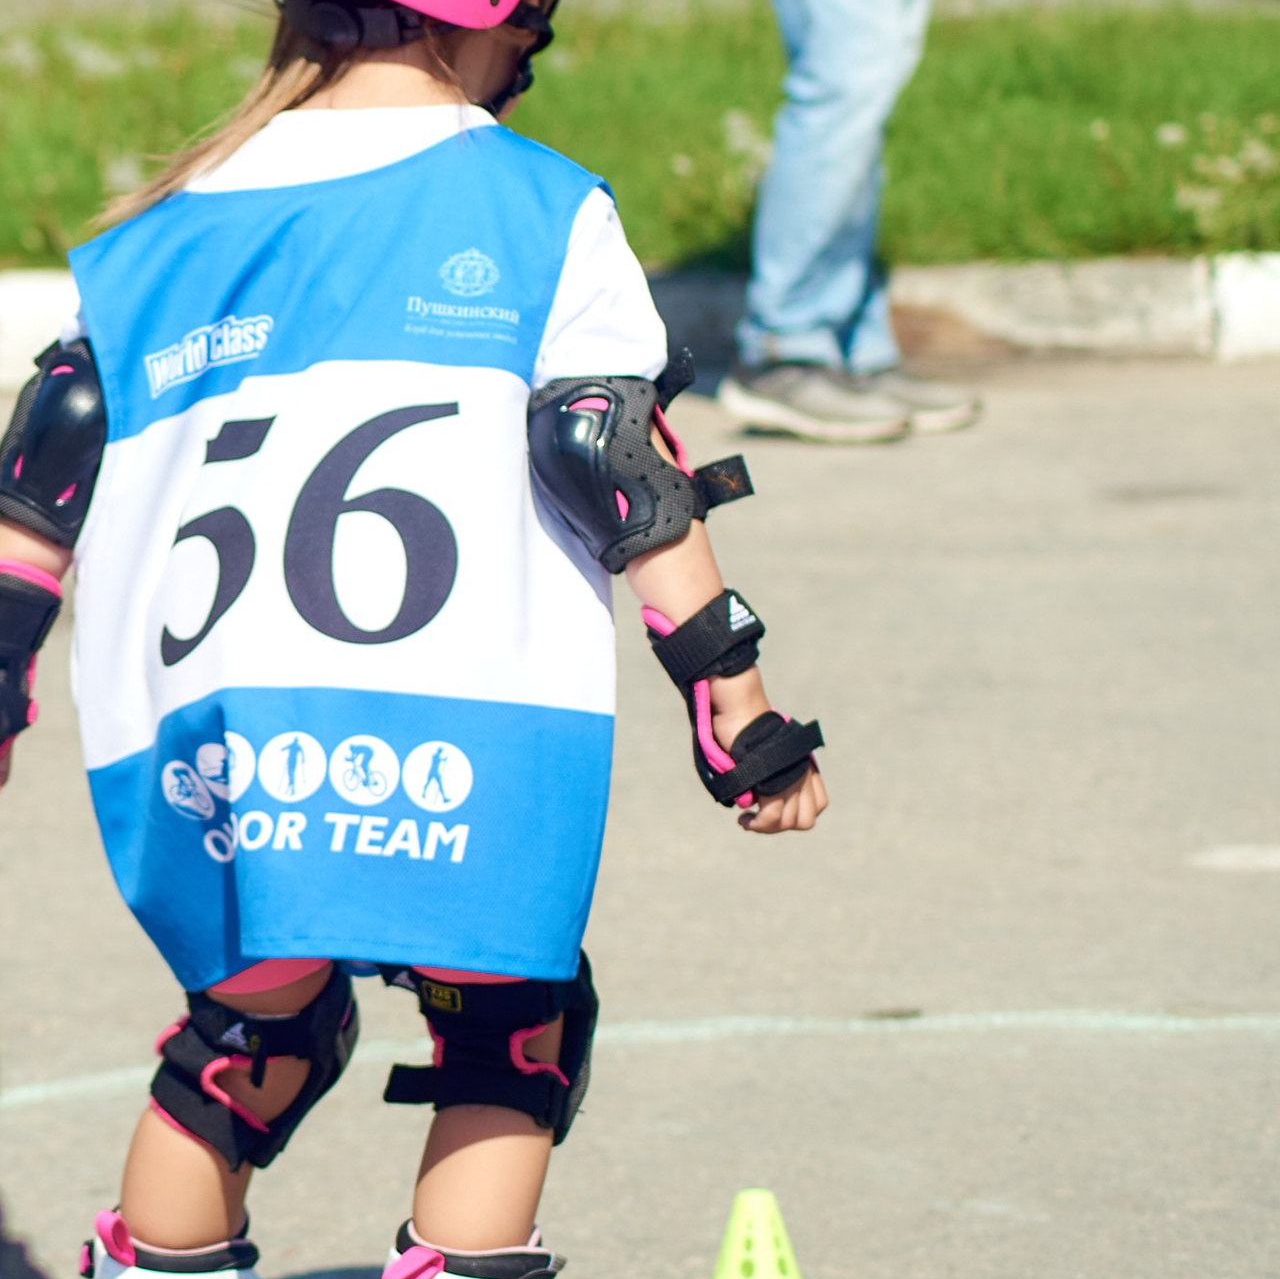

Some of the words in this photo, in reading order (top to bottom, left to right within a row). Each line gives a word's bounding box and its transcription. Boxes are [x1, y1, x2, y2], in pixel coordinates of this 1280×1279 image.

[406, 295, 519, 324] Пушкинский
[209, 321, 269, 361] Class
[160, 401, 460, 666] 56
[324, 812, 470, 863] TEAM
